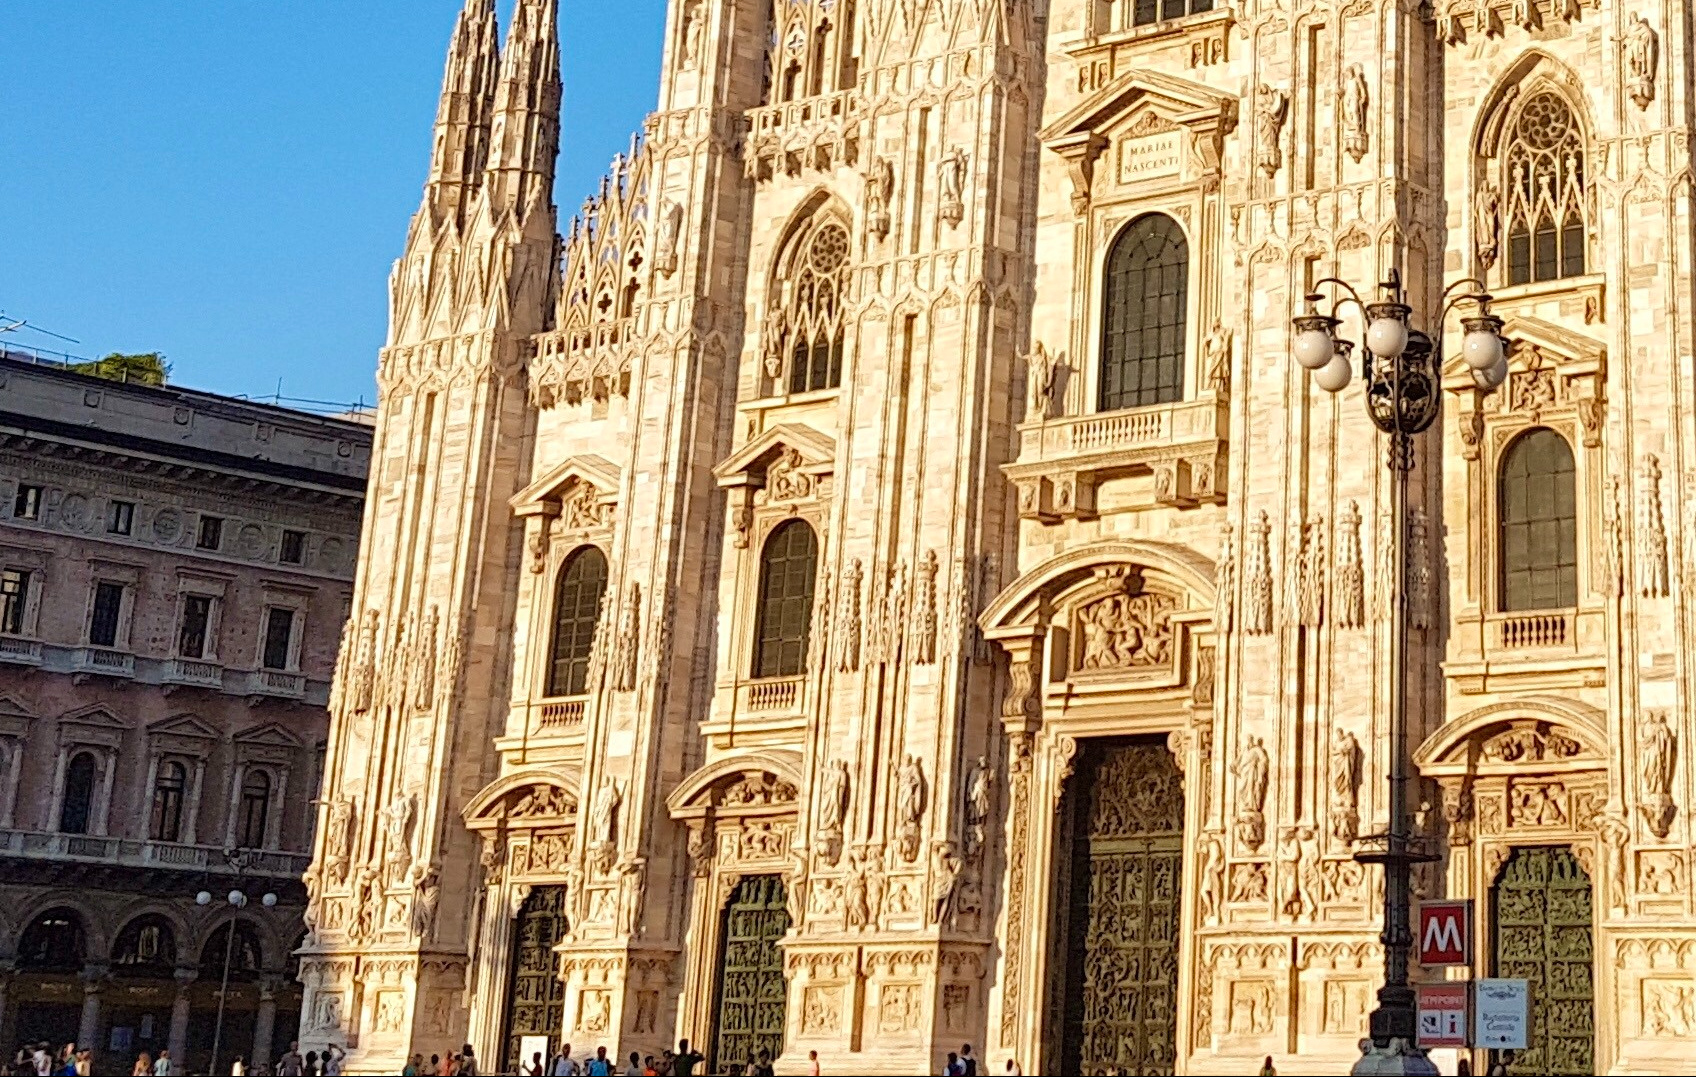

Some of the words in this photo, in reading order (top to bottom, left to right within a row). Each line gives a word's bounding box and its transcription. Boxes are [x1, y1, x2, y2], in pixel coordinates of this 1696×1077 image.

[1130, 141, 1173, 155] MARIAE
[1124, 157, 1178, 174] NASCENTI
[1422, 915, 1463, 953] M
